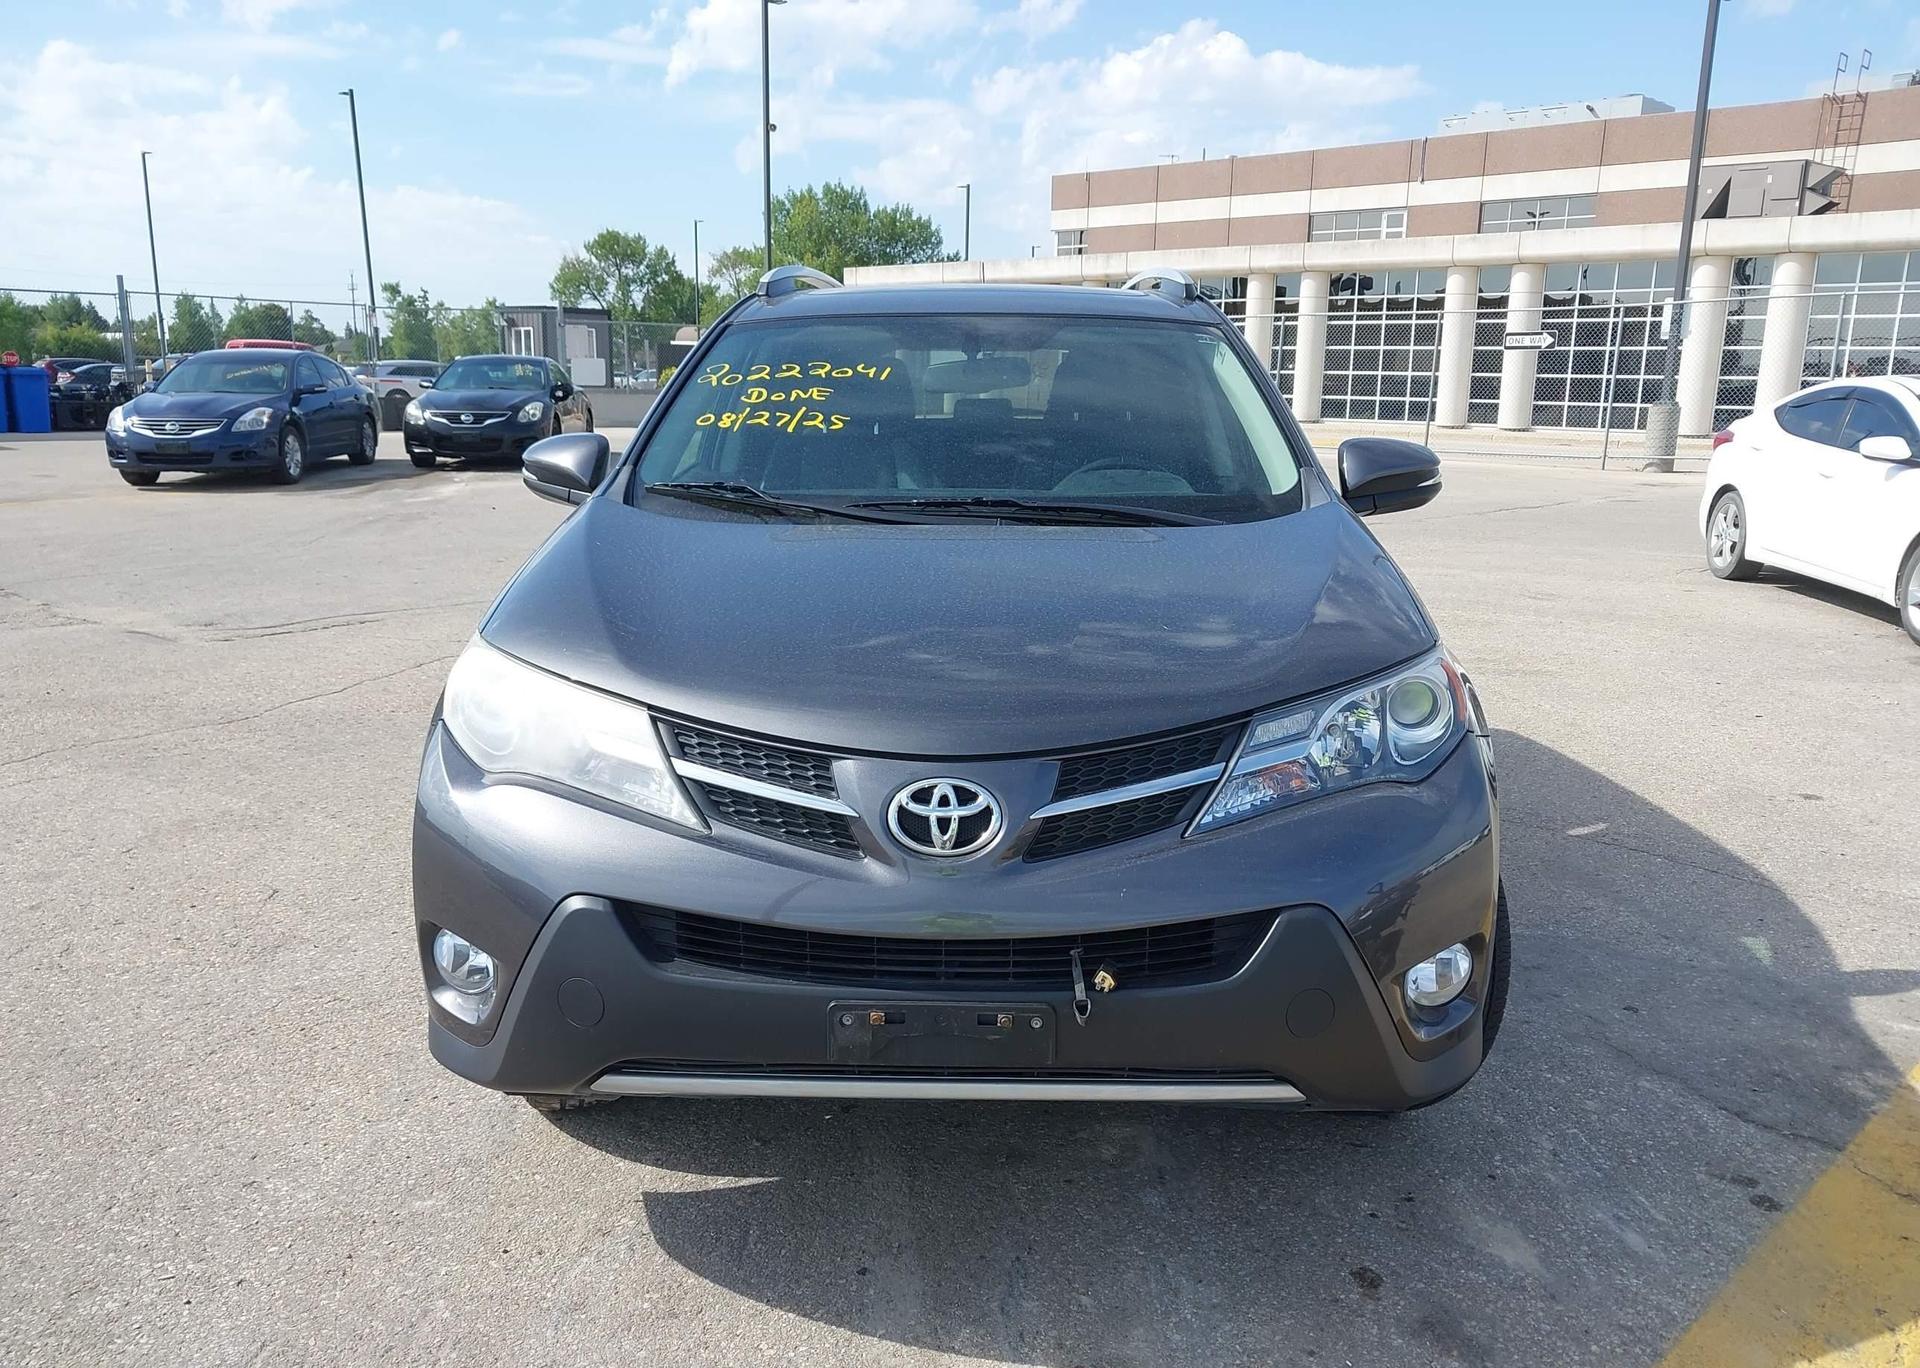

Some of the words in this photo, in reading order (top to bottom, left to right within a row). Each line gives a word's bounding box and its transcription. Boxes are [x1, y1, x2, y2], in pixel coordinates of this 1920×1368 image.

[1508, 337, 1526, 345] ONE
[1529, 336, 1548, 344] WAY
[697, 361, 892, 387] 20222041
[740, 387, 834, 404] DONE
[696, 406, 851, 433] 08/27/25
